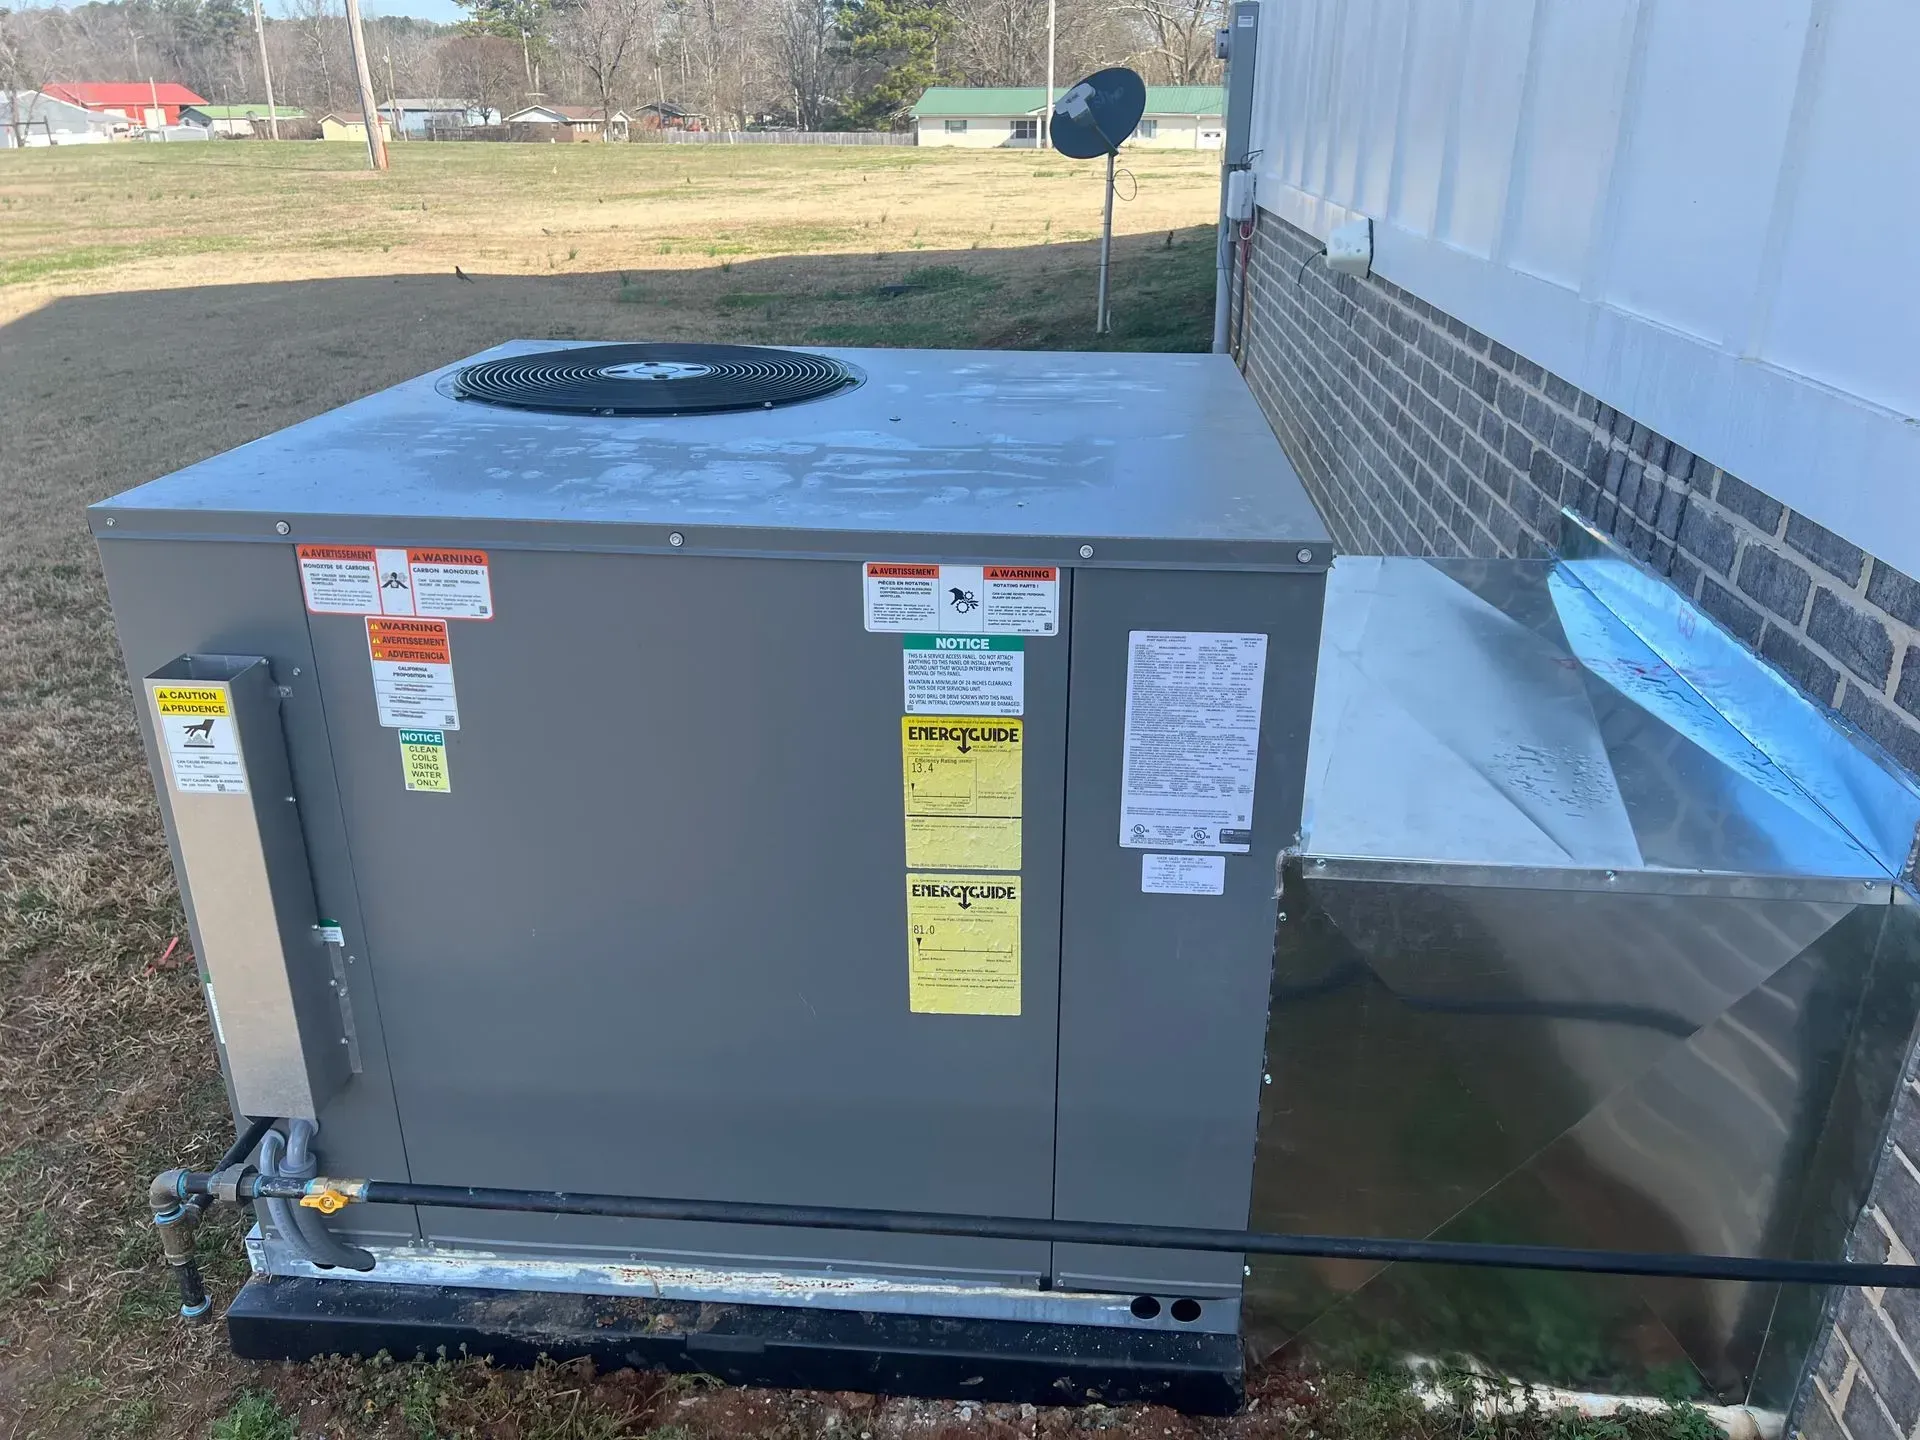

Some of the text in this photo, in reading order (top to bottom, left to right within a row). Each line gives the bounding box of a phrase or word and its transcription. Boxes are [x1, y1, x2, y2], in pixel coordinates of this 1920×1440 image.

[312, 549, 372, 559] AVERTISSEMENT
[422, 553, 483, 563] WARNING
[1000, 570, 1049, 578] WARNING
[380, 622, 443, 632] WARNING
[382, 636, 445, 646] AVERTISSEMENT
[936, 638, 990, 649] NOTICE
[388, 650, 445, 660] ADVERTENCIA
[170, 692, 217, 700] CAUTION
[172, 705, 225, 713] PRUDENCE
[402, 733, 441, 743] NOTICE
[909, 726, 1019, 742] ENERGYGUIDE
[912, 763, 934, 773] 13.4
[912, 884, 1016, 900] ENERGYGUIDE
[913, 925, 935, 934] 81.0
